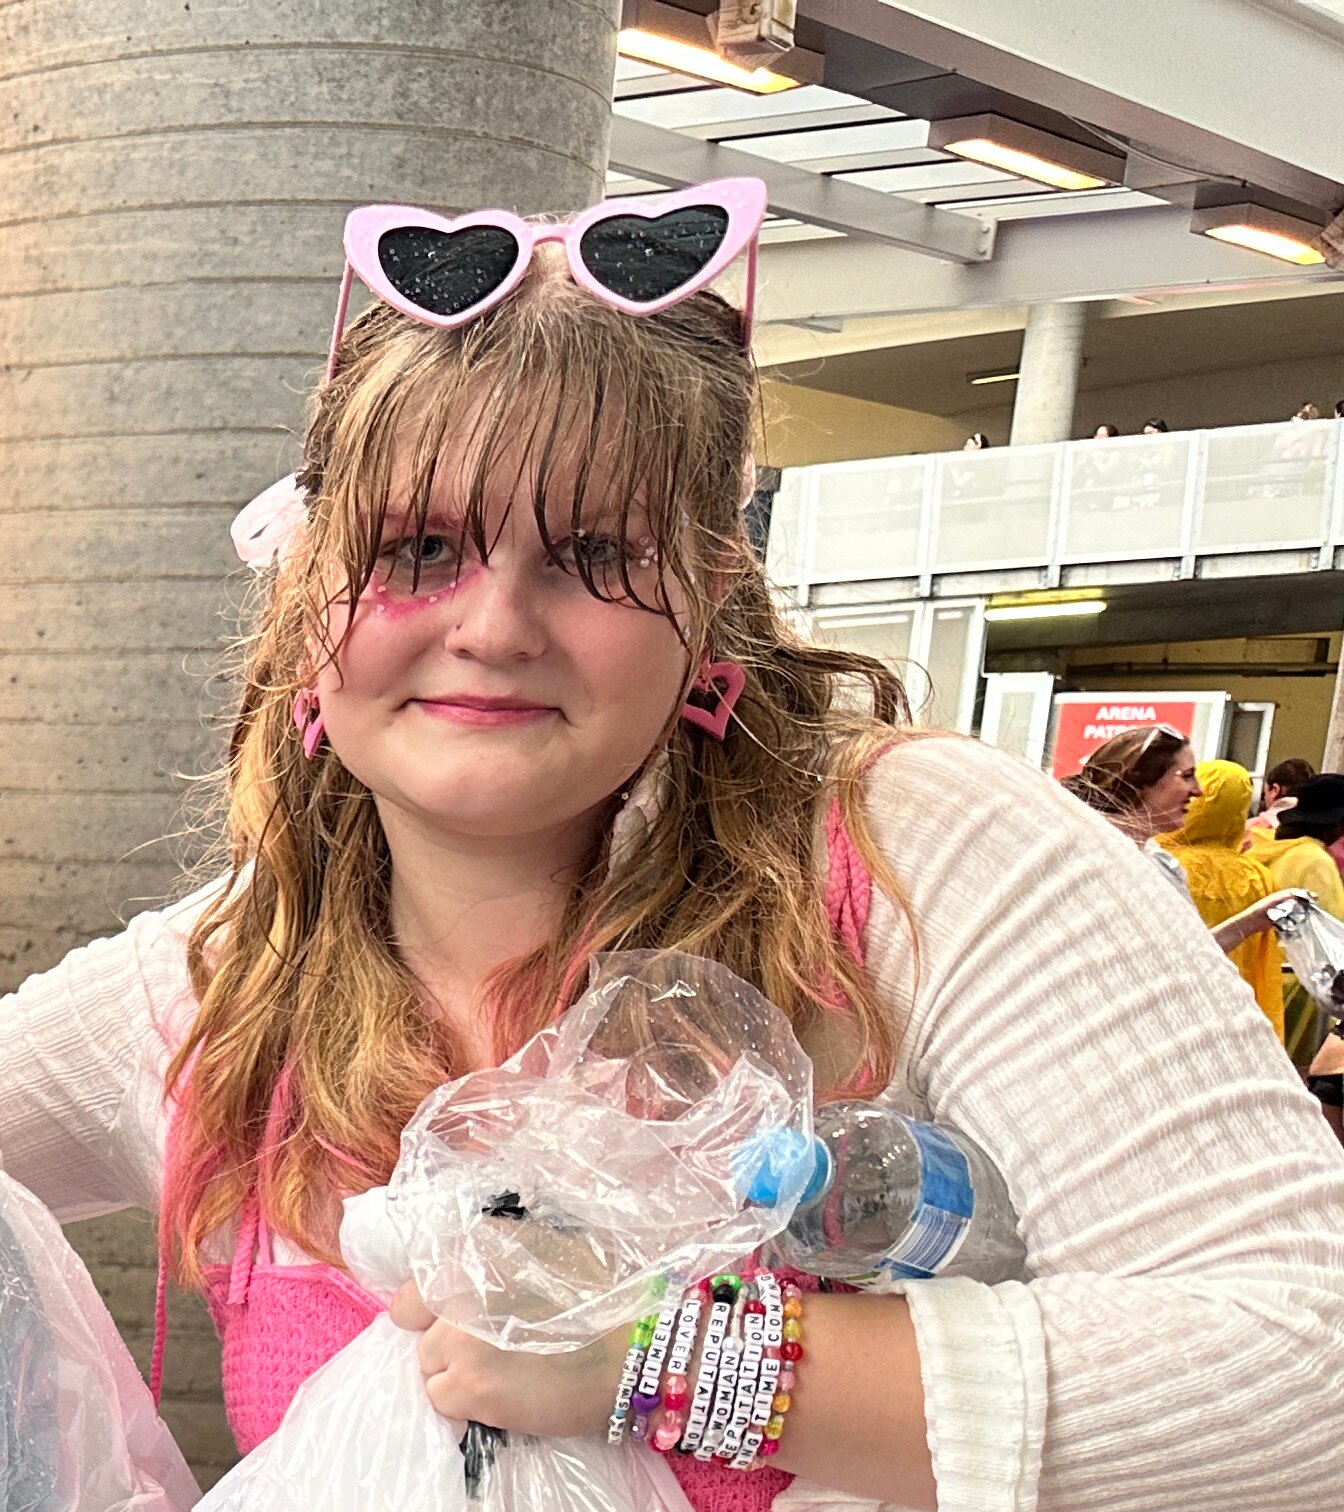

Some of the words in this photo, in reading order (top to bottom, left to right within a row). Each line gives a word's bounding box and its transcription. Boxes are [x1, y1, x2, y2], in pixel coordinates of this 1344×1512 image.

[1096, 706, 1156, 720] ARENA
[670, 1302, 699, 1369] LOVER
[684, 1304, 727, 1449] REPUTATION
[712, 1355, 736, 1430] WOMAN
[719, 1316, 761, 1457] REPUTATION
[737, 1438, 760, 1466] ONG
[755, 1364, 778, 1421] TIME
